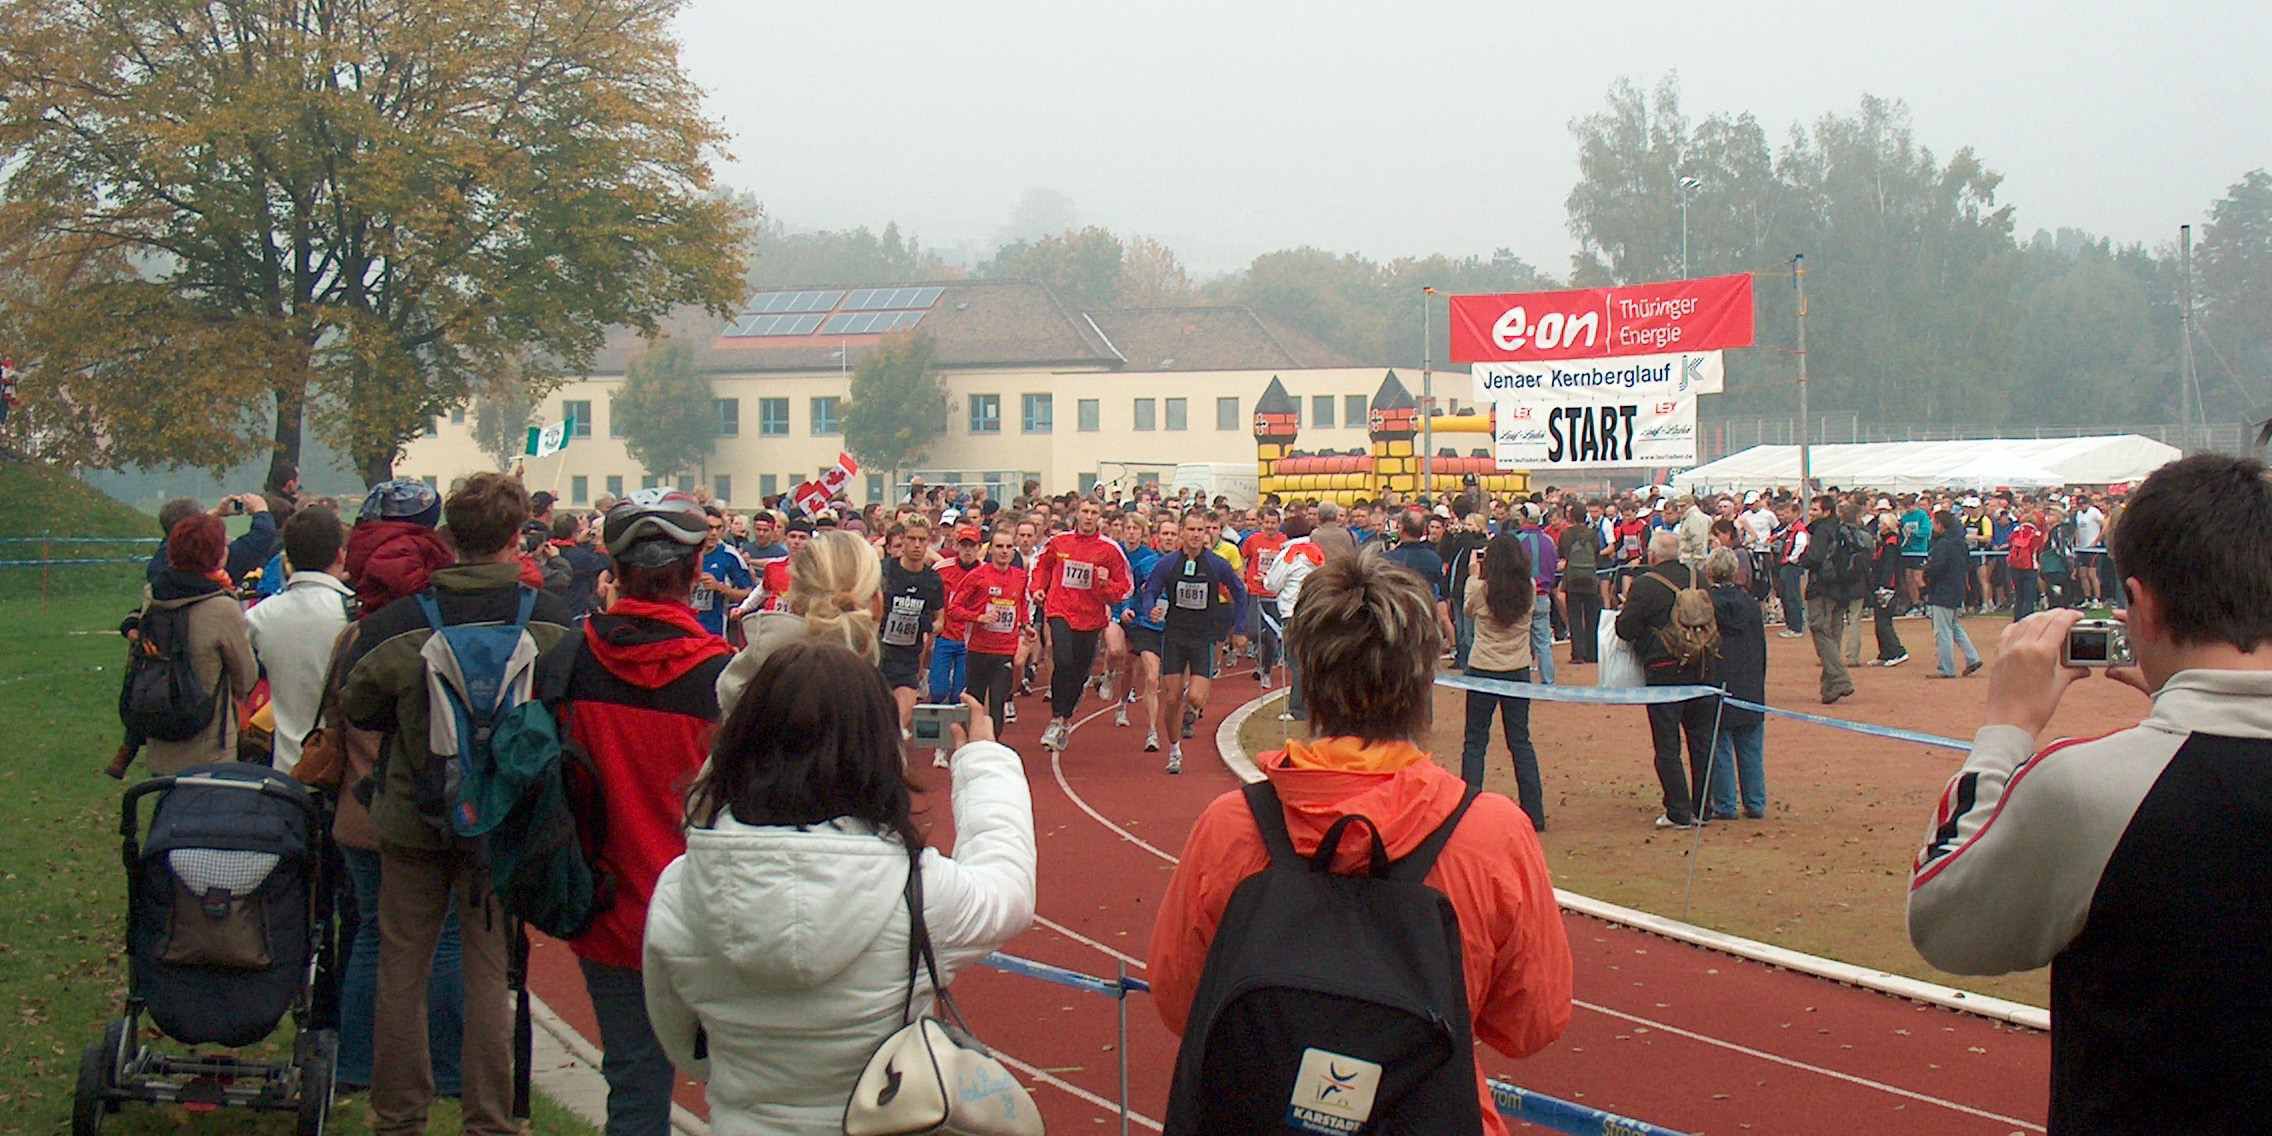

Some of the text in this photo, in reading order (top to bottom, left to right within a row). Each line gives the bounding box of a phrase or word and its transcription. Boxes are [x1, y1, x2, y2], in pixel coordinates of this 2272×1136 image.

[1619, 297, 1698, 320] Thüringer
[1620, 323, 1681, 348] Energie
[1484, 363, 1671, 389] Jenaer Kernberglauf
[1548, 405, 1637, 462] START
[1180, 588, 1203, 600] 1681
[1293, 1106, 1361, 1133] KARSTADT
